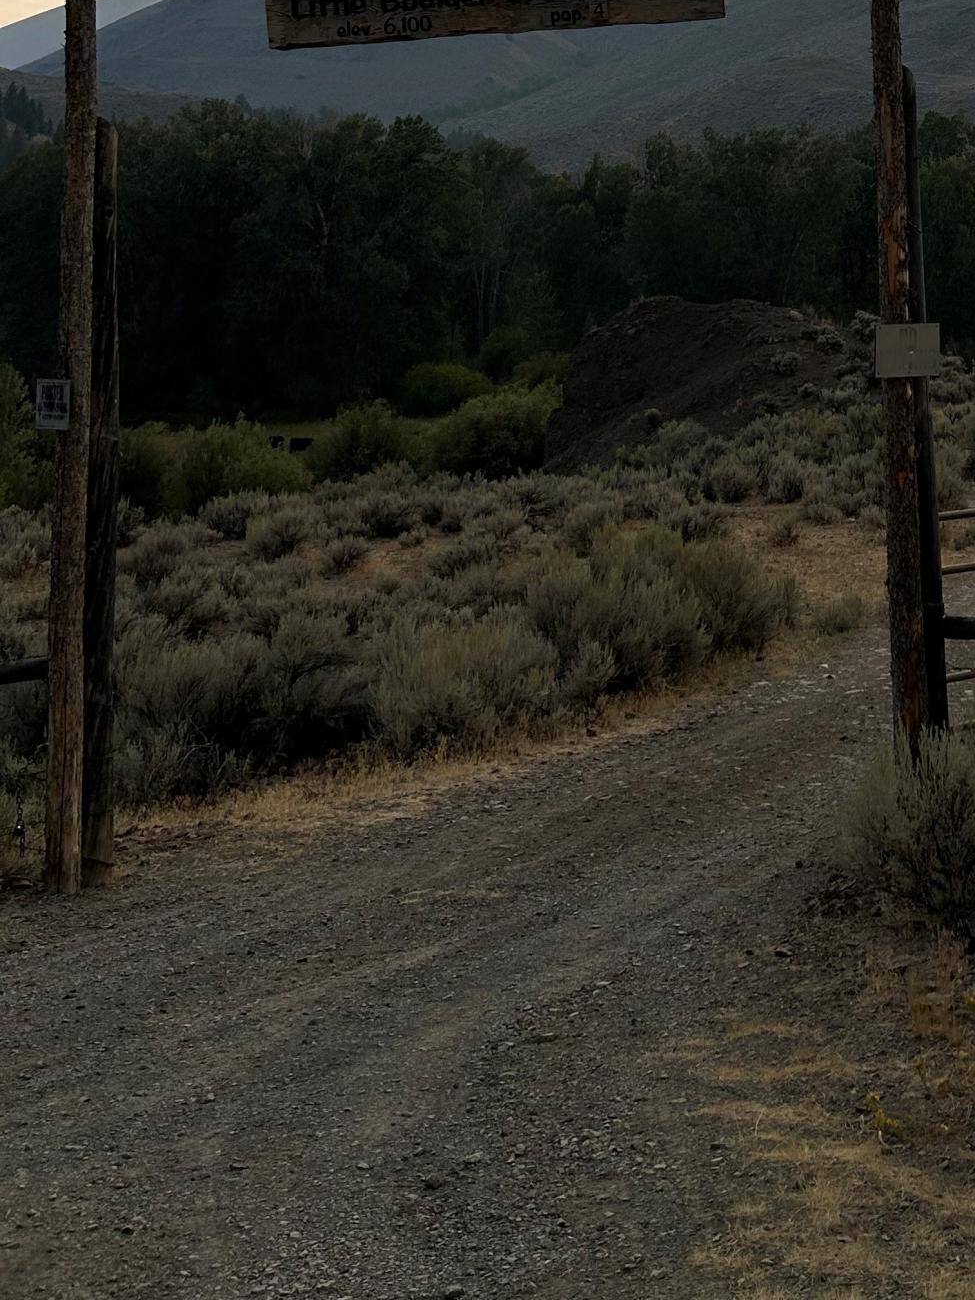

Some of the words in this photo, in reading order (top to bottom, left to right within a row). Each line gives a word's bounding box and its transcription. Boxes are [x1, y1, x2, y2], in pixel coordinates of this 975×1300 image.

[383, 14, 433, 35] 6,100
[550, 8, 587, 26] pop.
[593, 3, 605, 19] 4
